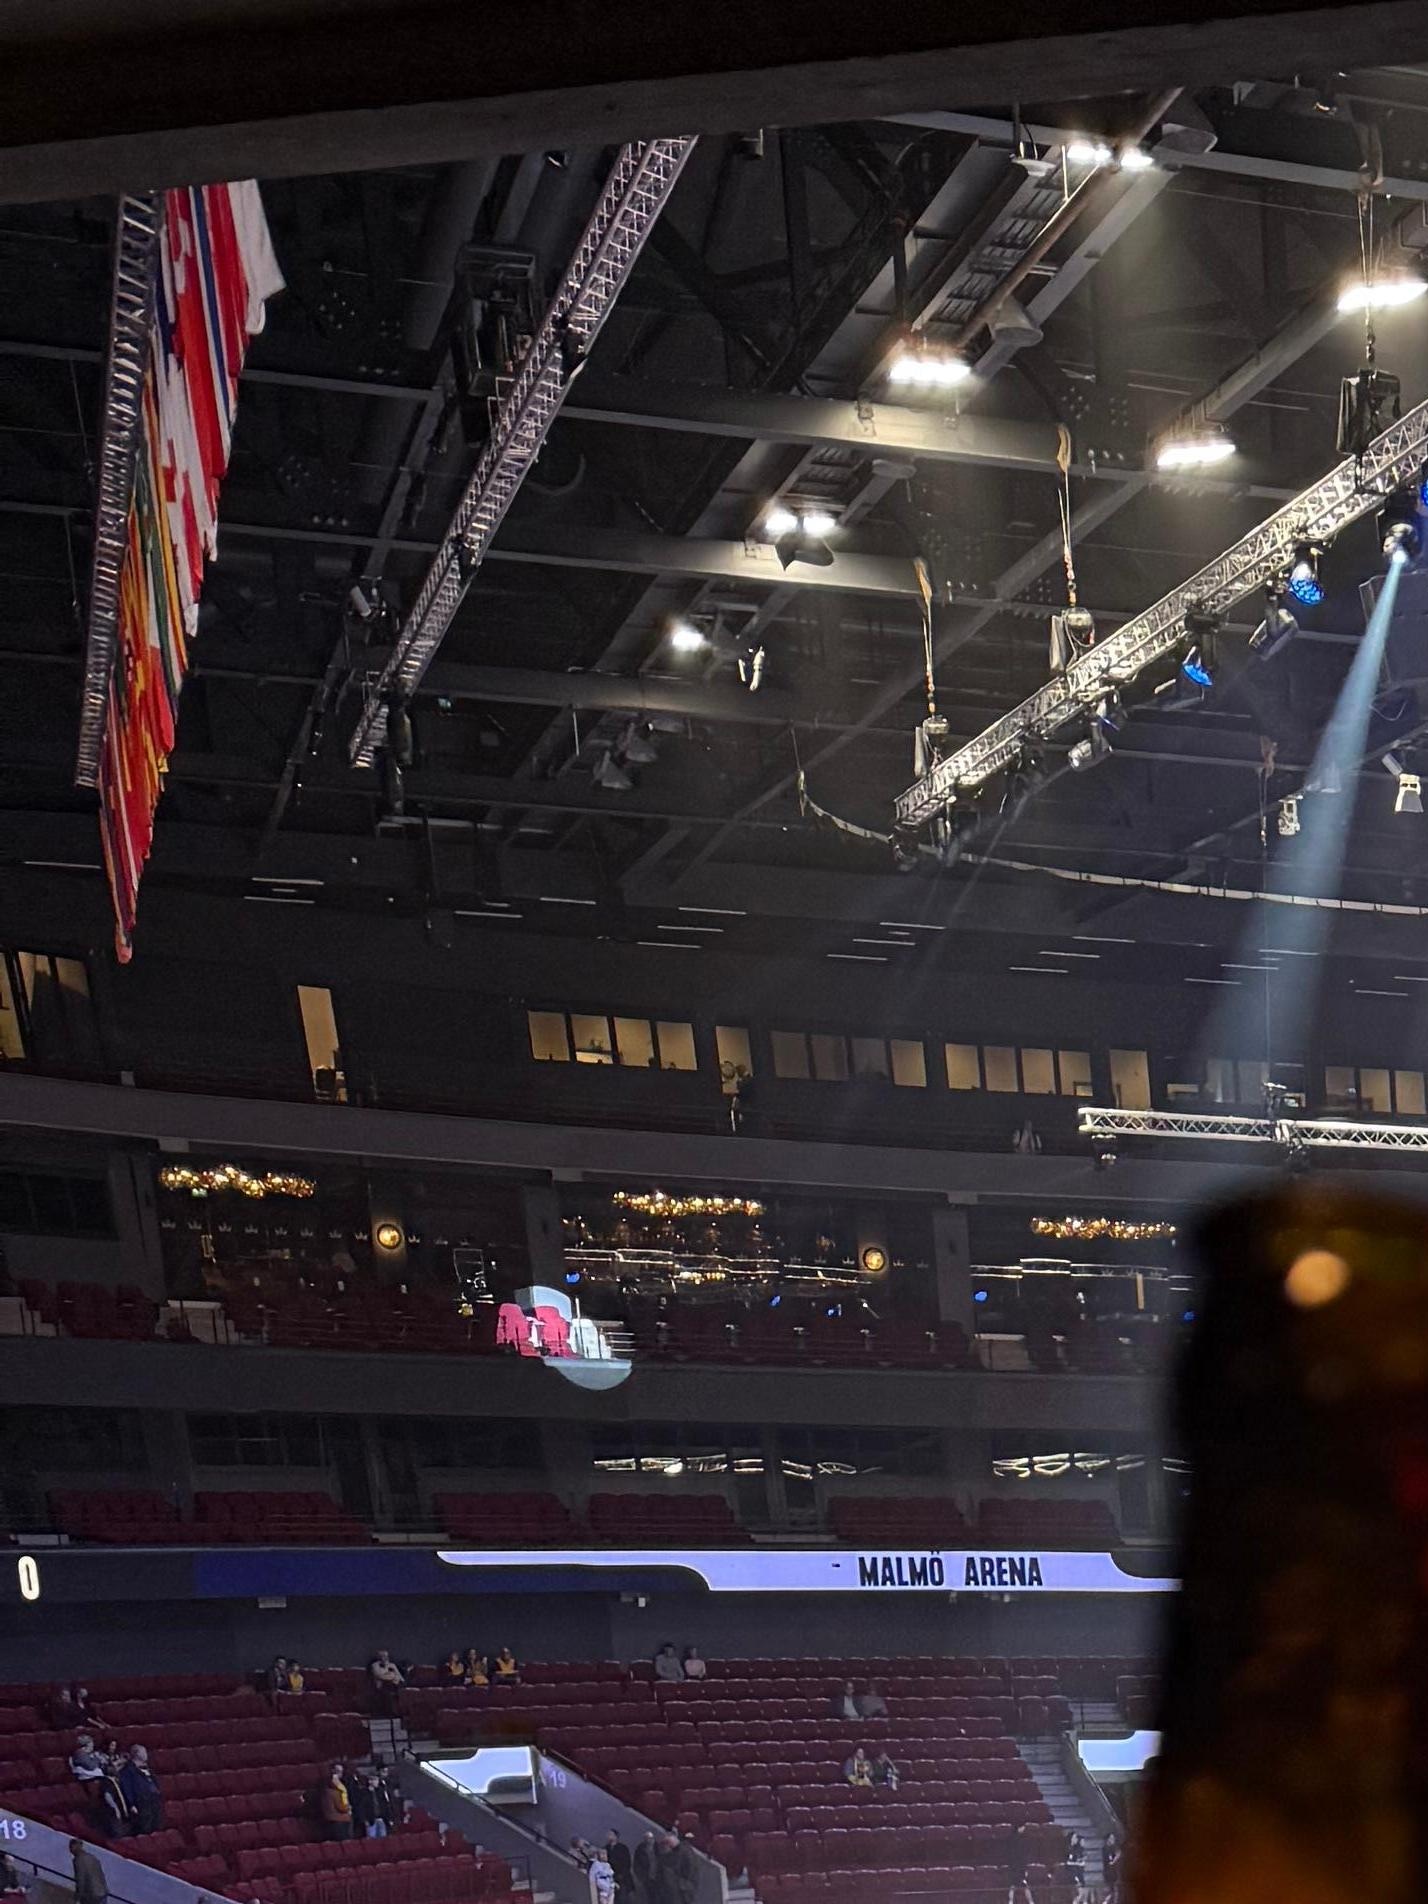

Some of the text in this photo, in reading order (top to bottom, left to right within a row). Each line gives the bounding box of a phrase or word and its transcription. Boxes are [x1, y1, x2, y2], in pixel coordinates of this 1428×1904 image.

[18, 1555, 40, 1600] 0
[857, 1550, 1044, 1587] MALMÖ ARENA
